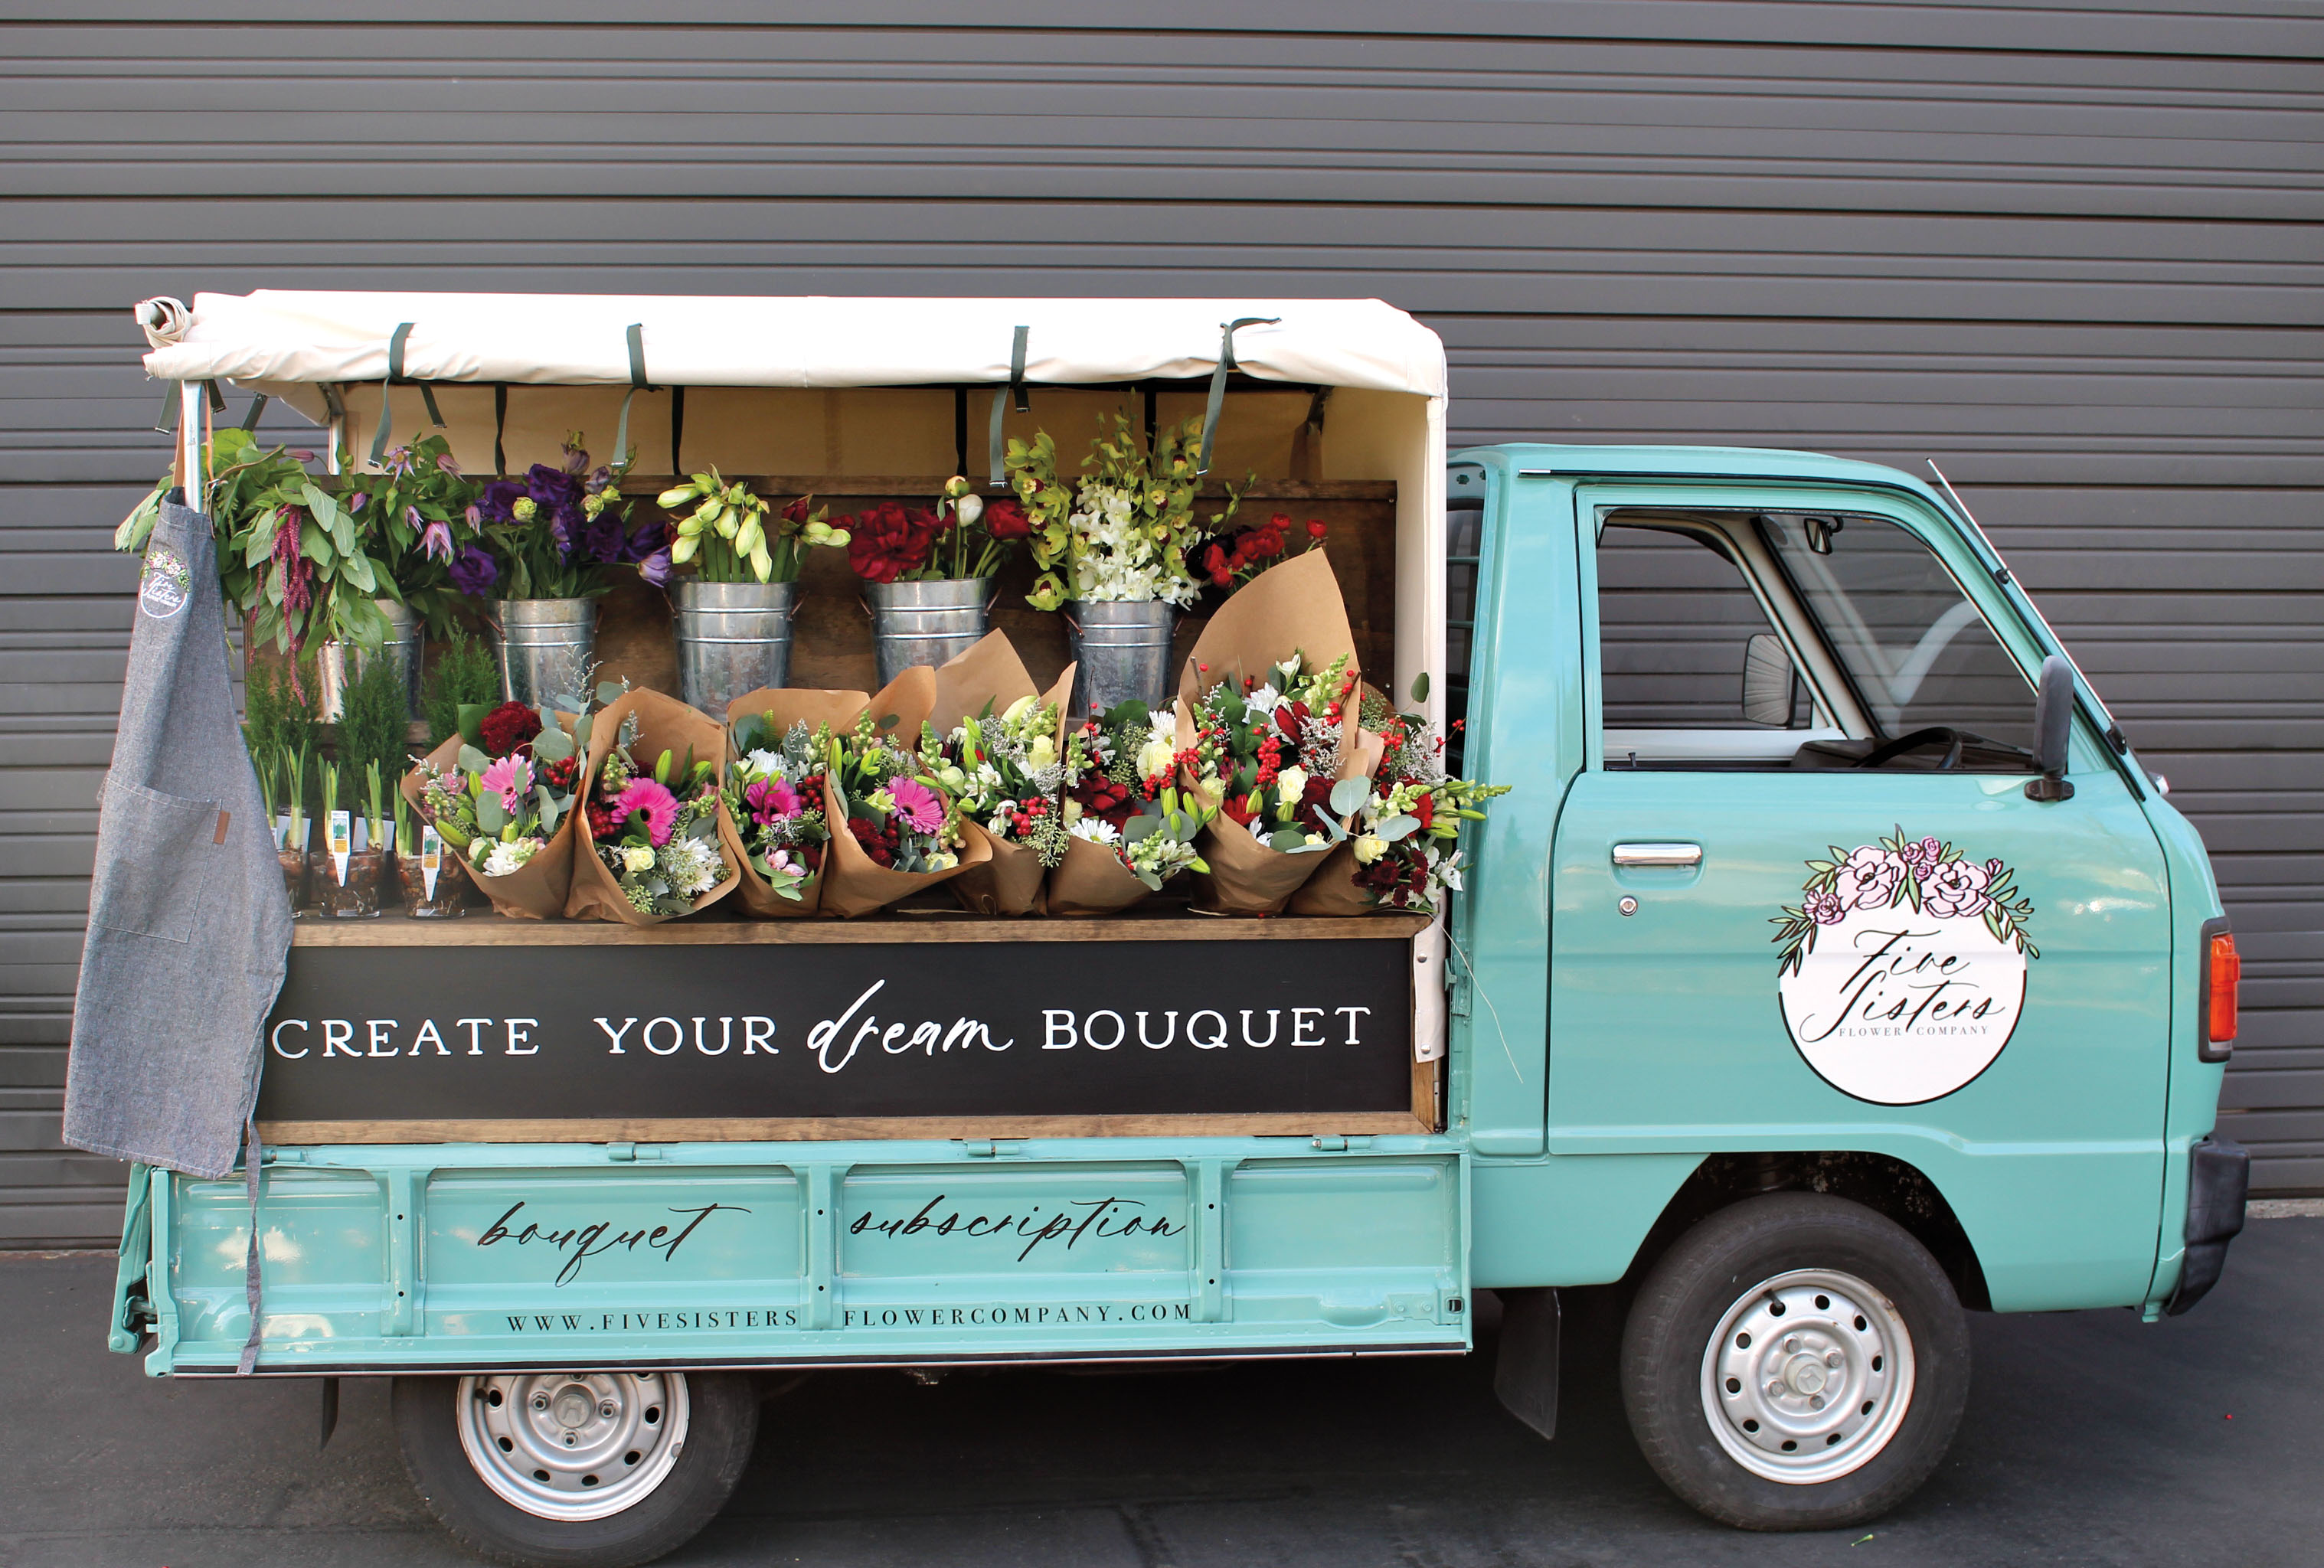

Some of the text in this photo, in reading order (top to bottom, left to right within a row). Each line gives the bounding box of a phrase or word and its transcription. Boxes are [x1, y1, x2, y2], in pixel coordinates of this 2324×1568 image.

[1839, 929, 1971, 995] Five
[271, 978, 1372, 1074] CREATE YOUR dream BOUQUET
[1799, 970, 2006, 1043] Sisters
[1839, 1024, 1989, 1037] FLOWER COMPANY
[477, 1194, 1187, 1288] bouquet subscription
[506, 1303, 1191, 1331] WWW.FIVESISTERS FLOWERCOMPANY.COM
